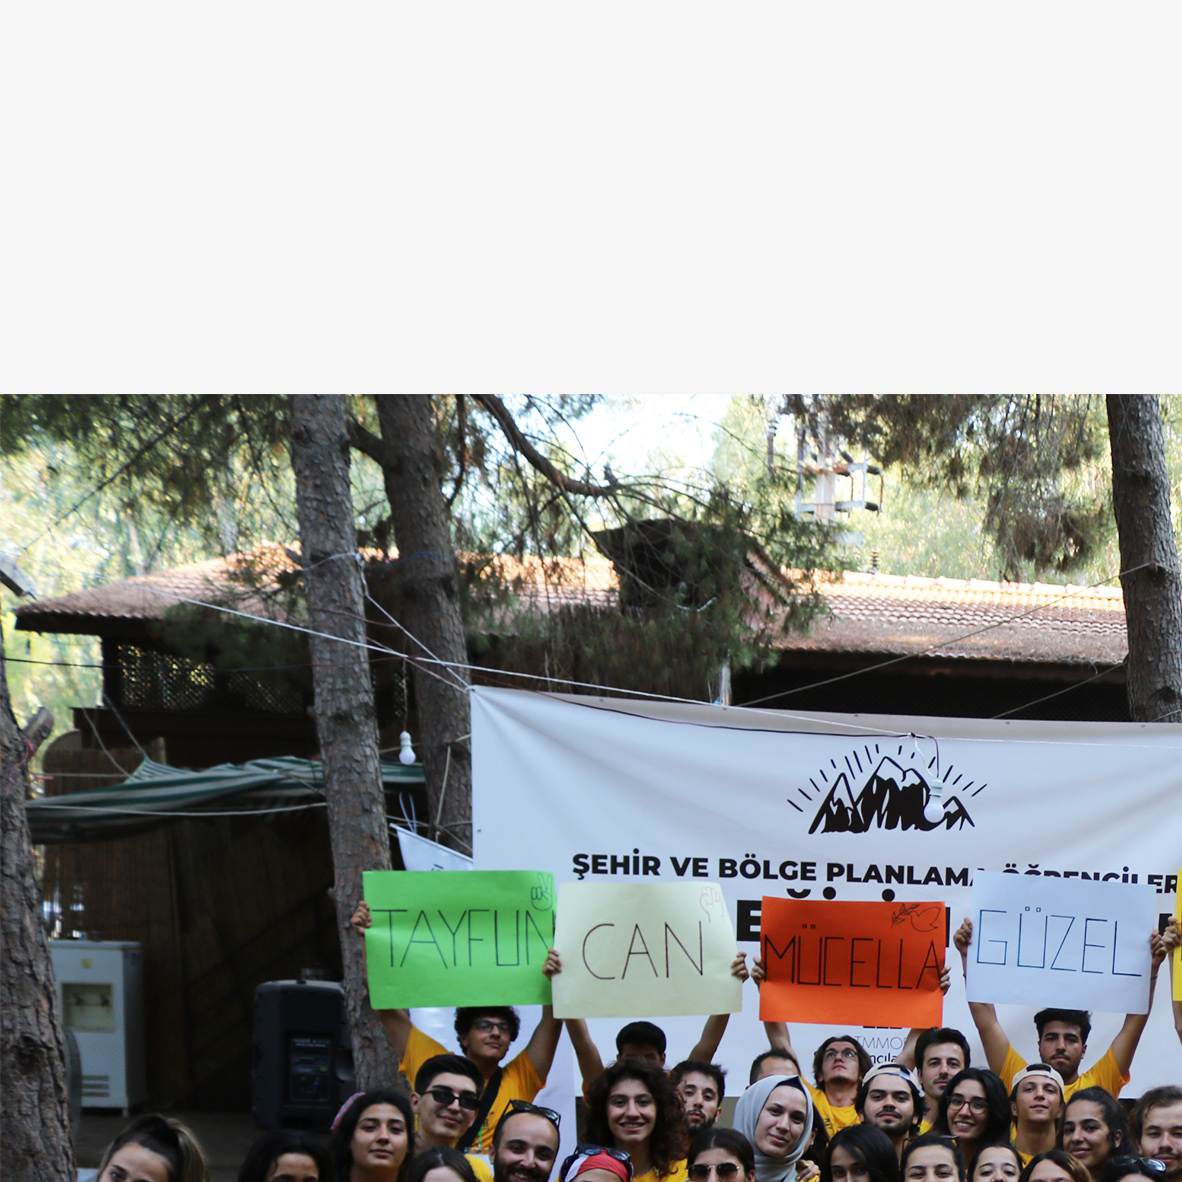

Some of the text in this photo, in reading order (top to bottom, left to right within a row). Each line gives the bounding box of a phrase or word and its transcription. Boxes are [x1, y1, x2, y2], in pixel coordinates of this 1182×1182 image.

[572, 848, 661, 880] ŞEHİR
[669, 857, 709, 878] VE
[718, 853, 817, 882] BÖLGE
[826, 862, 985, 887] PLANLAM
[373, 909, 555, 970] TAYFUN
[582, 921, 703, 980] CAN
[763, 924, 942, 990] MÜCELLA
[976, 906, 1142, 977] GÜZEL
[854, 1036, 907, 1051] TMMO
